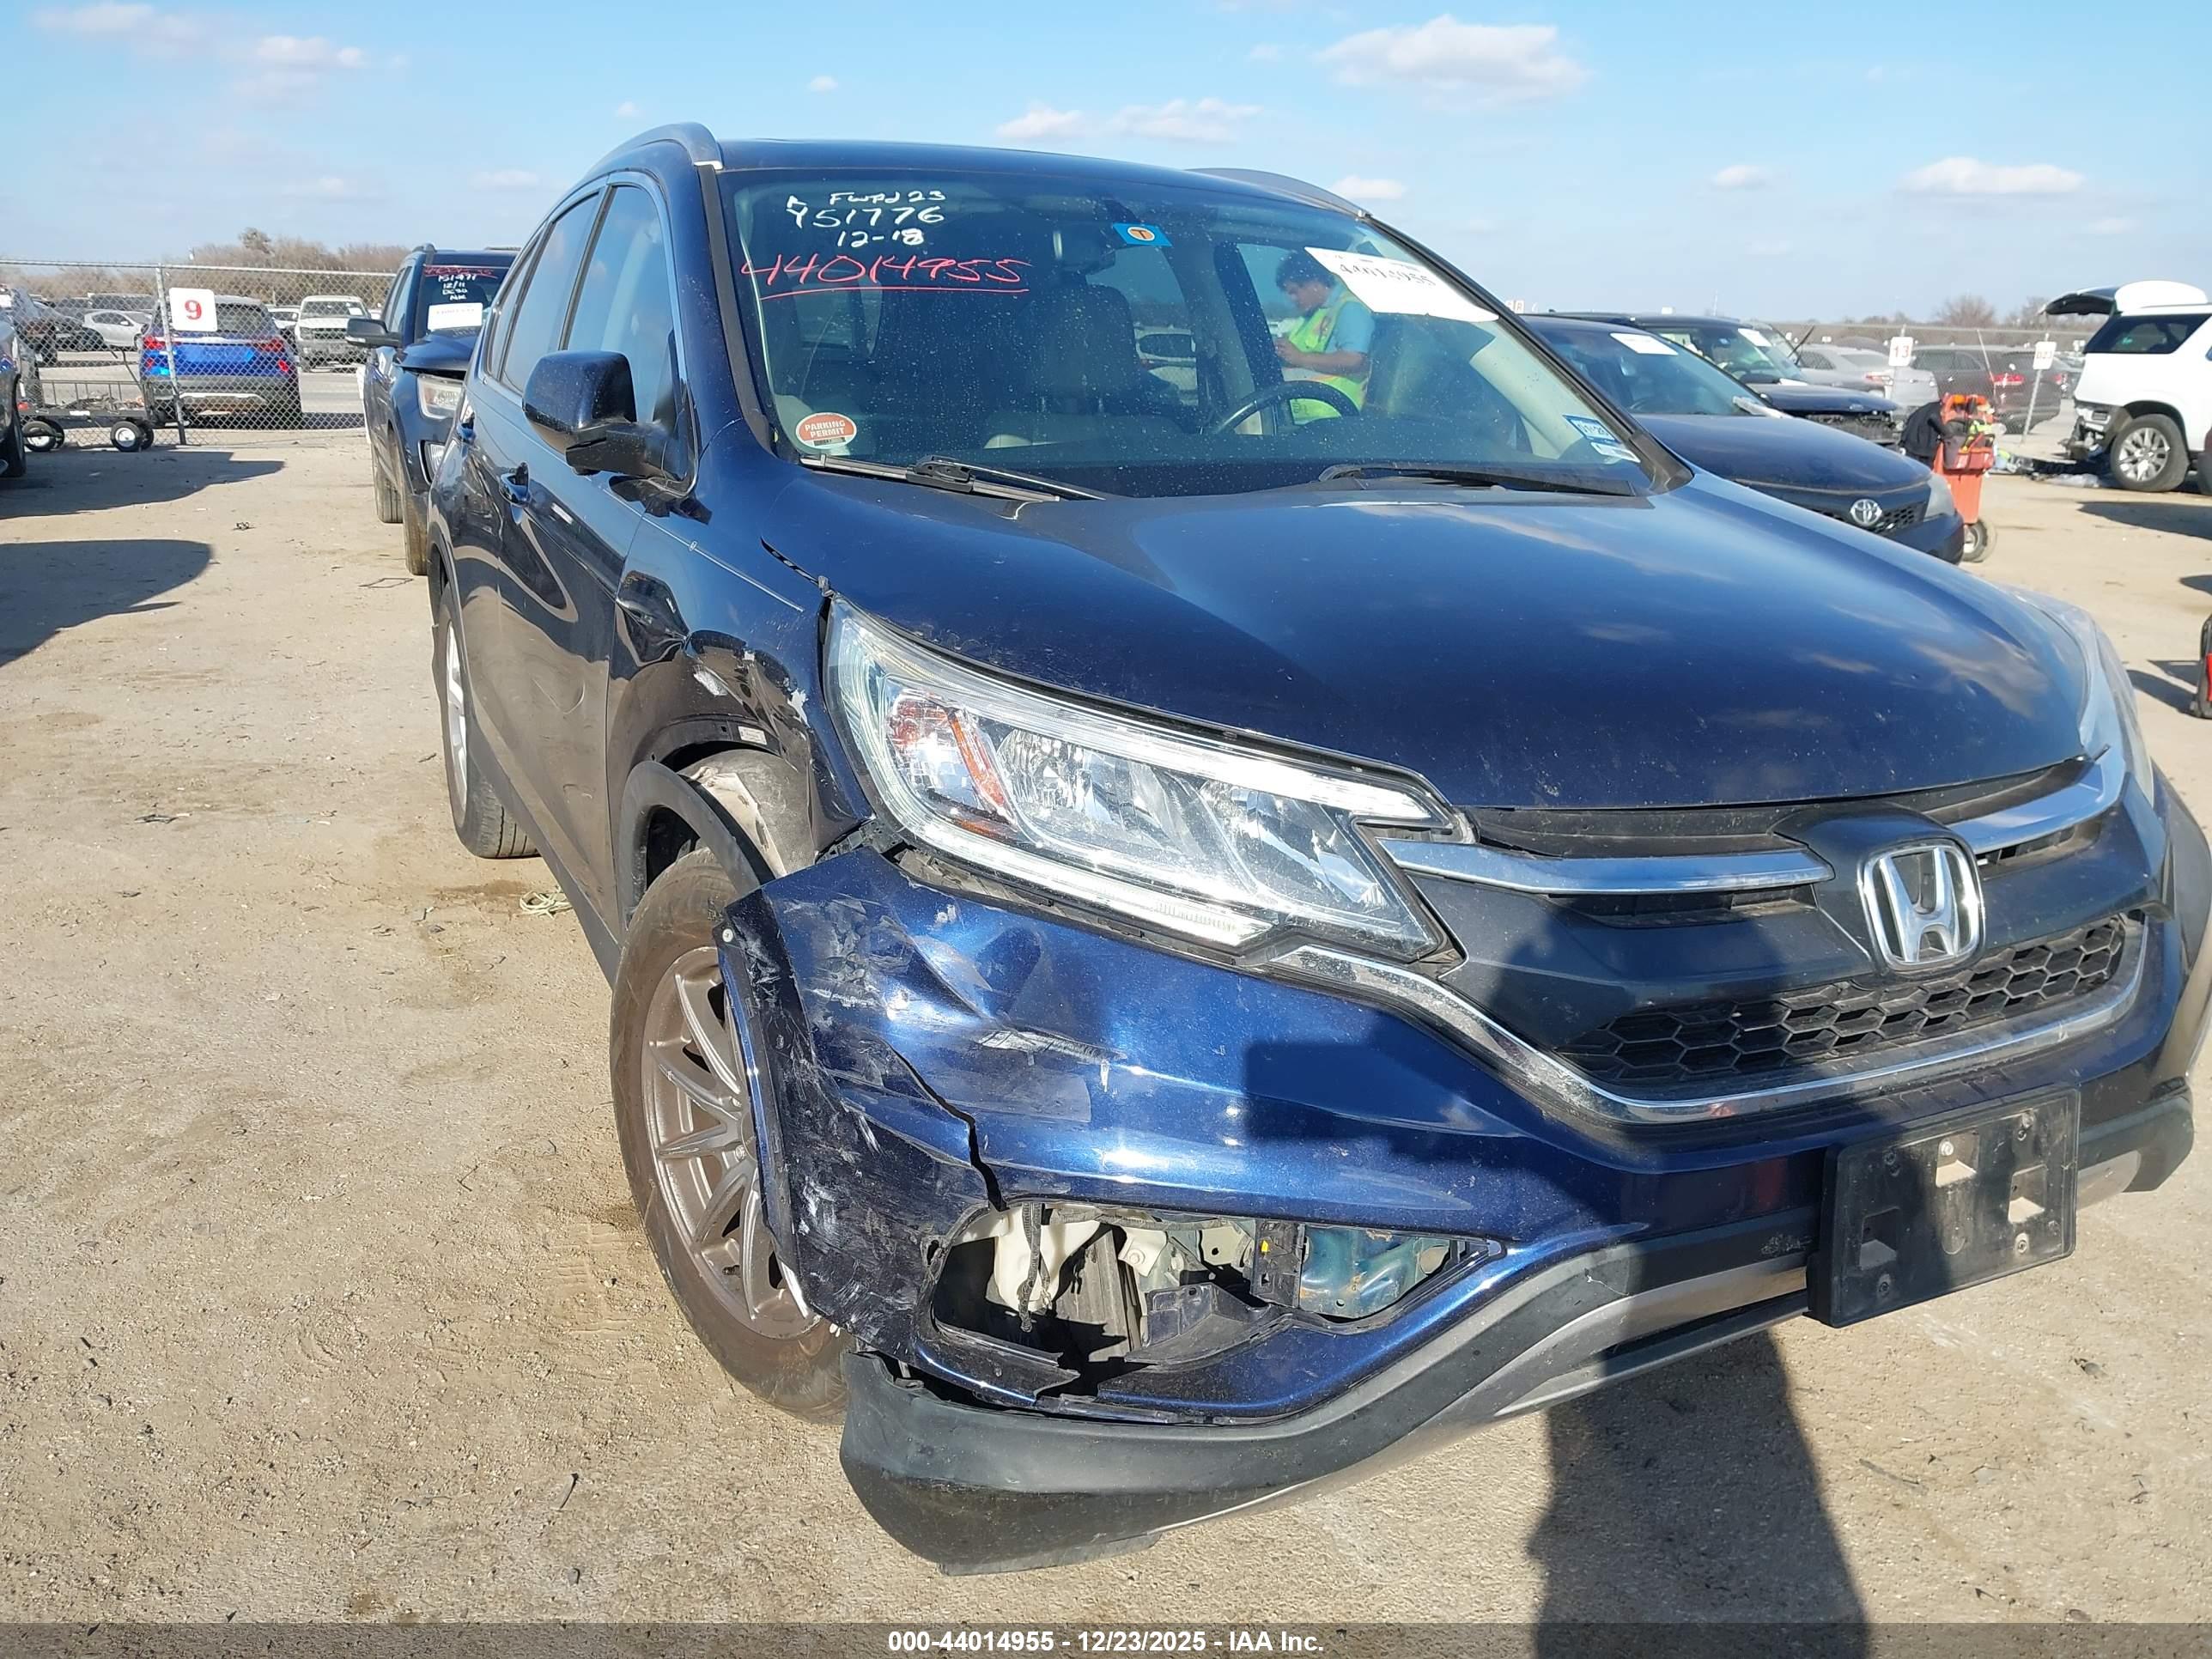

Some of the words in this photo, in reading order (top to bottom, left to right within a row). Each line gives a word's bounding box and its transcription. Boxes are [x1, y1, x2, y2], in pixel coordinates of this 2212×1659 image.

[908, 191, 946, 204] 23
[741, 253, 1032, 286] 44014955
[185, 300, 202, 320] 9
[1893, 344, 1910, 358] 13
[805, 420, 846, 431] PARKING
[811, 428, 845, 438] PERMIT
